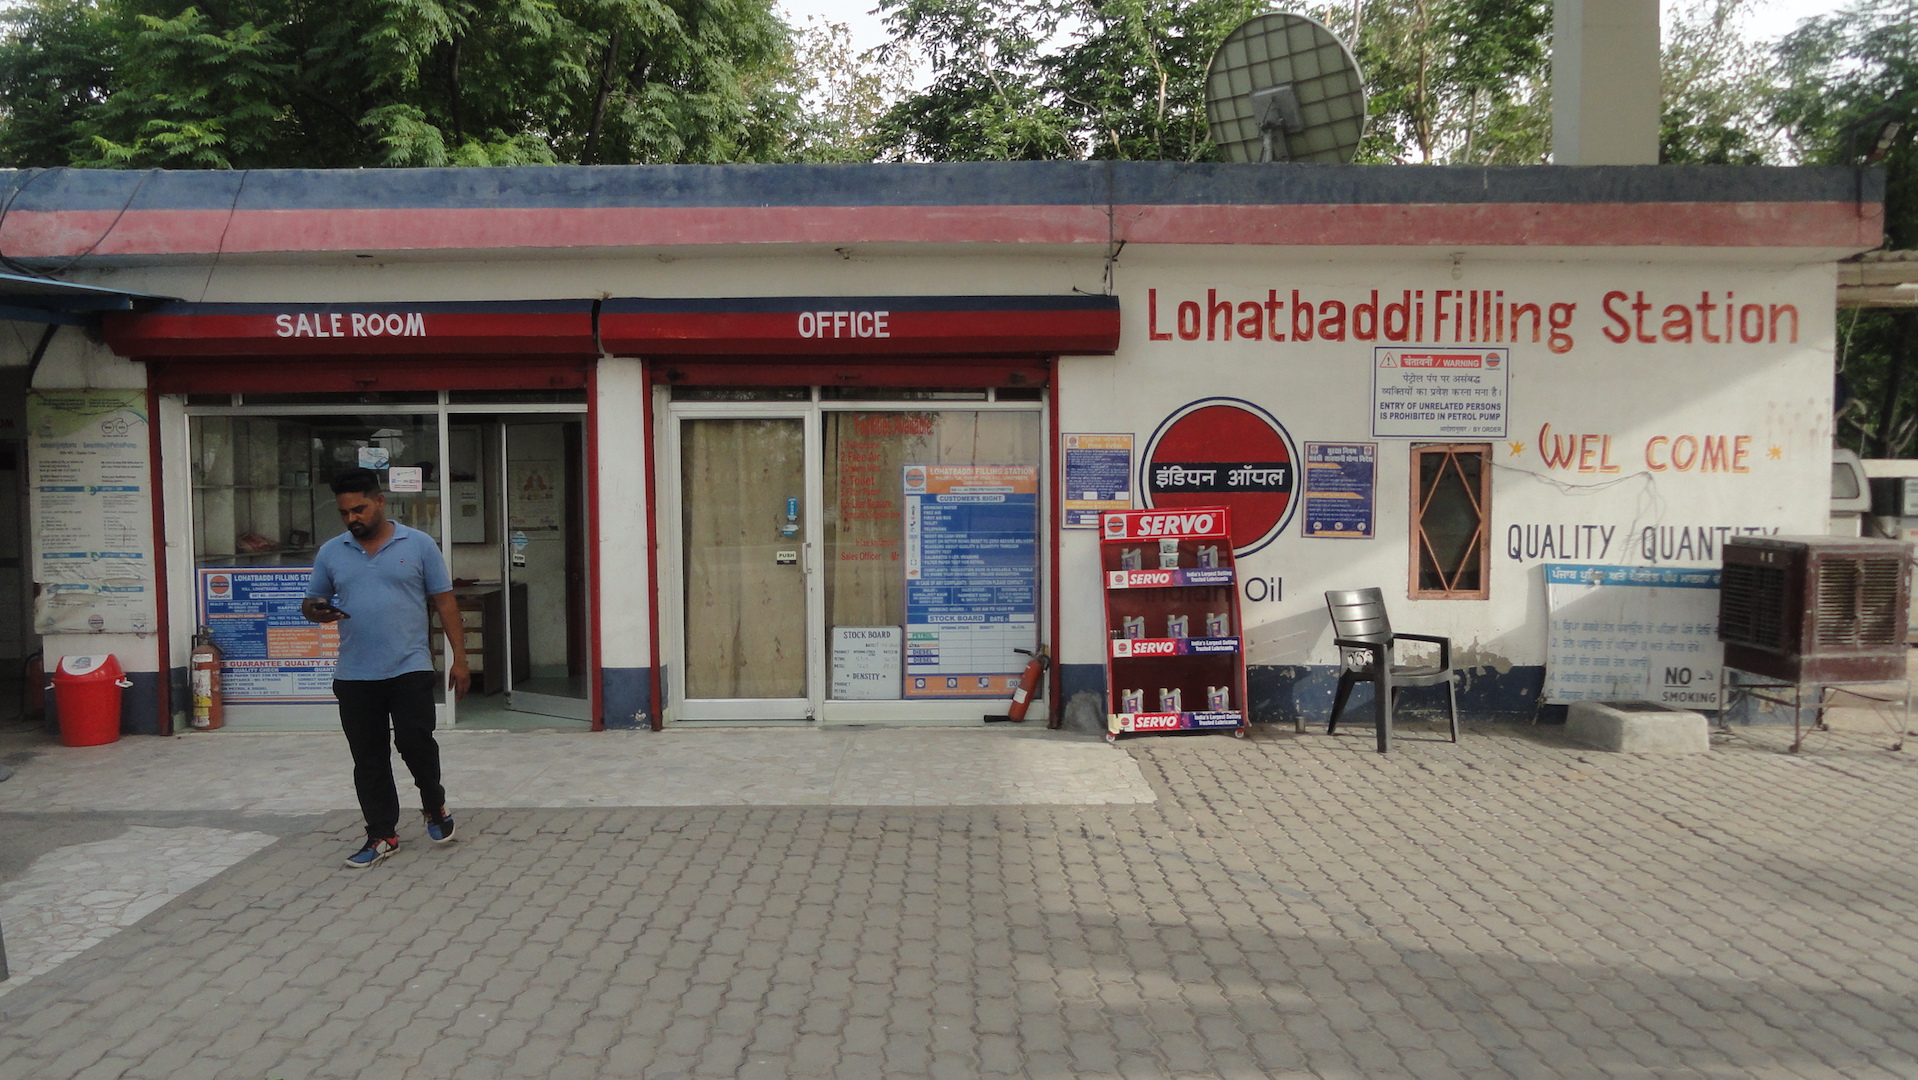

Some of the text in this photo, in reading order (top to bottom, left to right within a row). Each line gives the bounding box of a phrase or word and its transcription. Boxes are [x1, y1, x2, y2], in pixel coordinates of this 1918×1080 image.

[1602, 290, 1798, 343] Station
[276, 313, 426, 337] SALE ROOM
[798, 311, 890, 338] OFFICE
[1443, 355, 1480, 367] WARNING
[1440, 372, 1450, 384] पर
[1416, 386, 1427, 397] का
[1452, 386, 1472, 397] करना
[1475, 386, 1489, 397] मना
[1380, 402, 1501, 411] ENTRY OF UNRELATED PERSONS
[1380, 412, 1501, 420] IS PROHIBITED IN PETROL PUMP
[1539, 422, 1752, 474] WEL COME
[850, 475, 875, 486] Toilet
[1156, 465, 1217, 488] इंडियन
[1137, 514, 1214, 536] SERVO
[1508, 524, 1780, 563] QUALITY QUANT
[841, 552, 858, 561] Sales
[859, 552, 881, 561] Officer
[1129, 573, 1169, 584] SERVO
[1245, 577, 1282, 602] Oil
[843, 631, 891, 639] STOCK BOARD
[1133, 642, 1174, 654] SERVO
[1665, 667, 1692, 684] NO
[1663, 692, 1716, 702] SMOKING
[1136, 716, 1177, 728] SERVO
